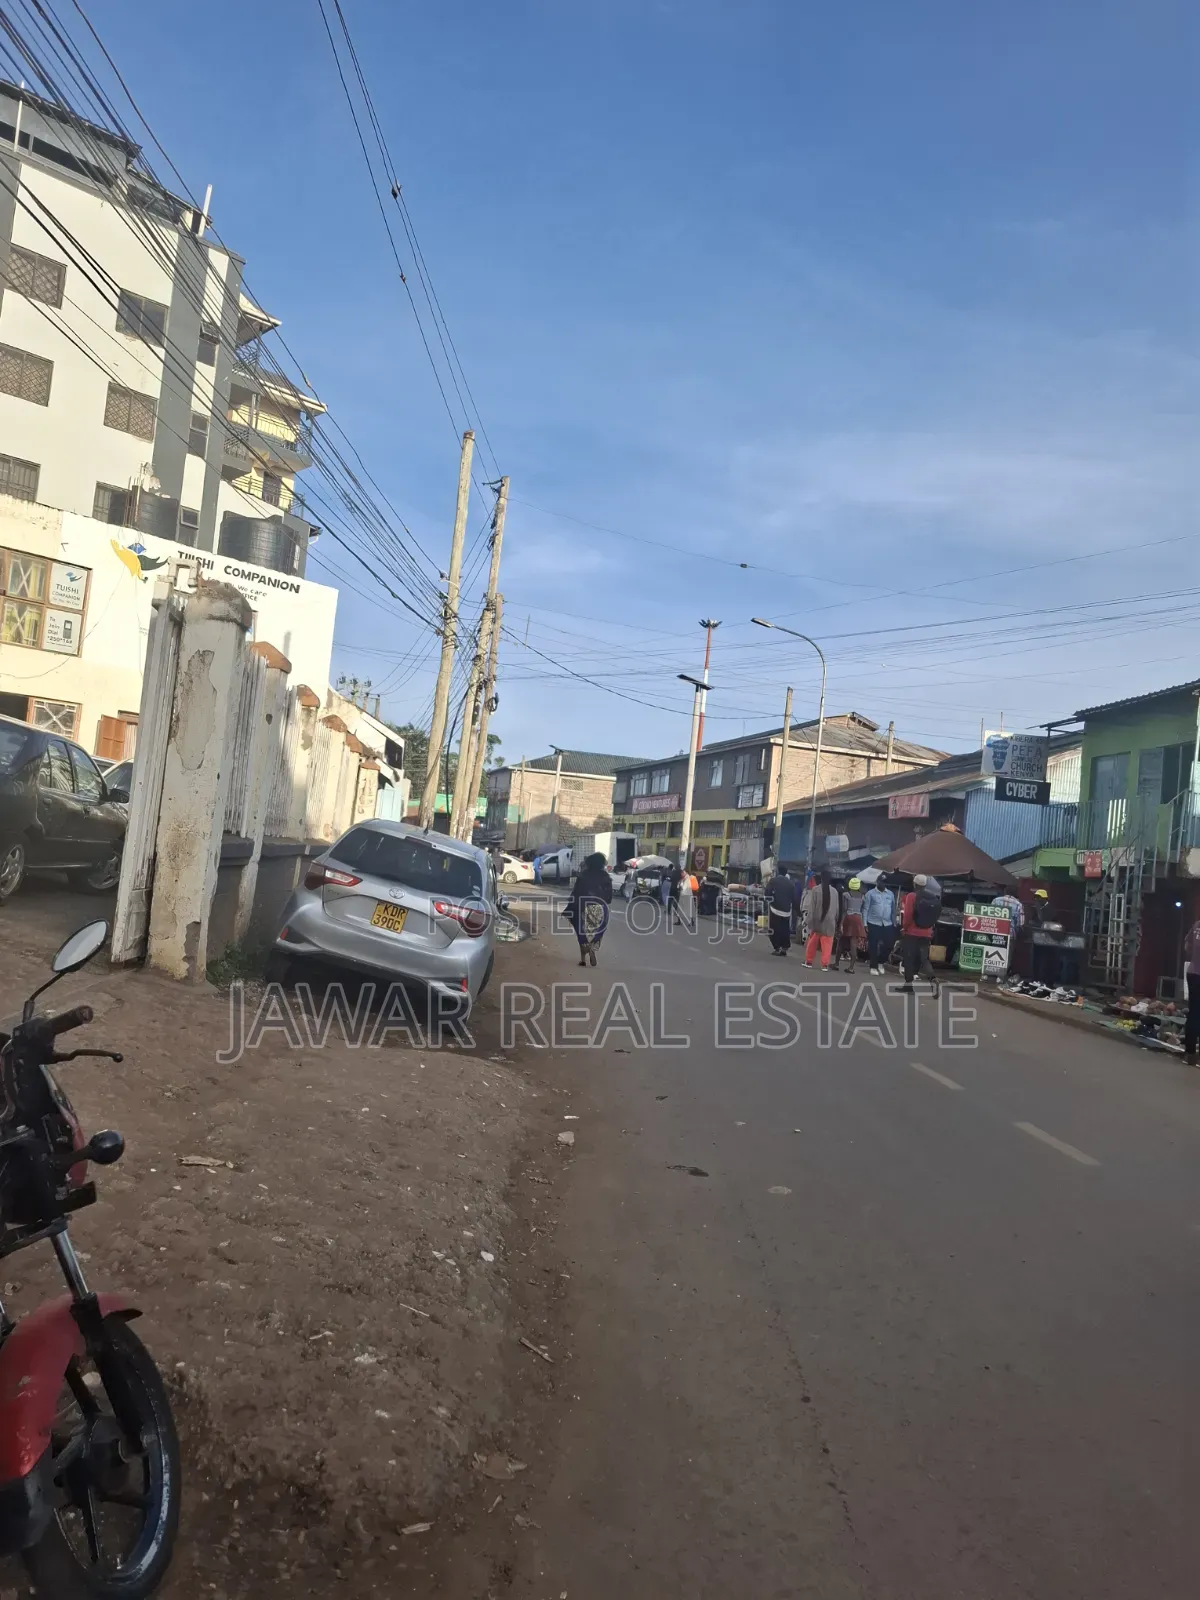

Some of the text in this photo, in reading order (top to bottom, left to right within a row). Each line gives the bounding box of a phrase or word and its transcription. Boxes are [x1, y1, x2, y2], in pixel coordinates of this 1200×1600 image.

[223, 565, 301, 594] COMPANION
[52, 590, 81, 601] COMPANION
[56, 583, 79, 595] TUISHI
[1011, 744, 1042, 760] PEFA
[1010, 762, 1043, 773] CHURCH
[1010, 770, 1034, 778] KENYA
[1006, 781, 1038, 799] CYBER
[382, 903, 406, 919] KDR
[980, 905, 1010, 919] PESA
[373, 914, 401, 932] 390C
[984, 958, 1005, 967] EQUITY
